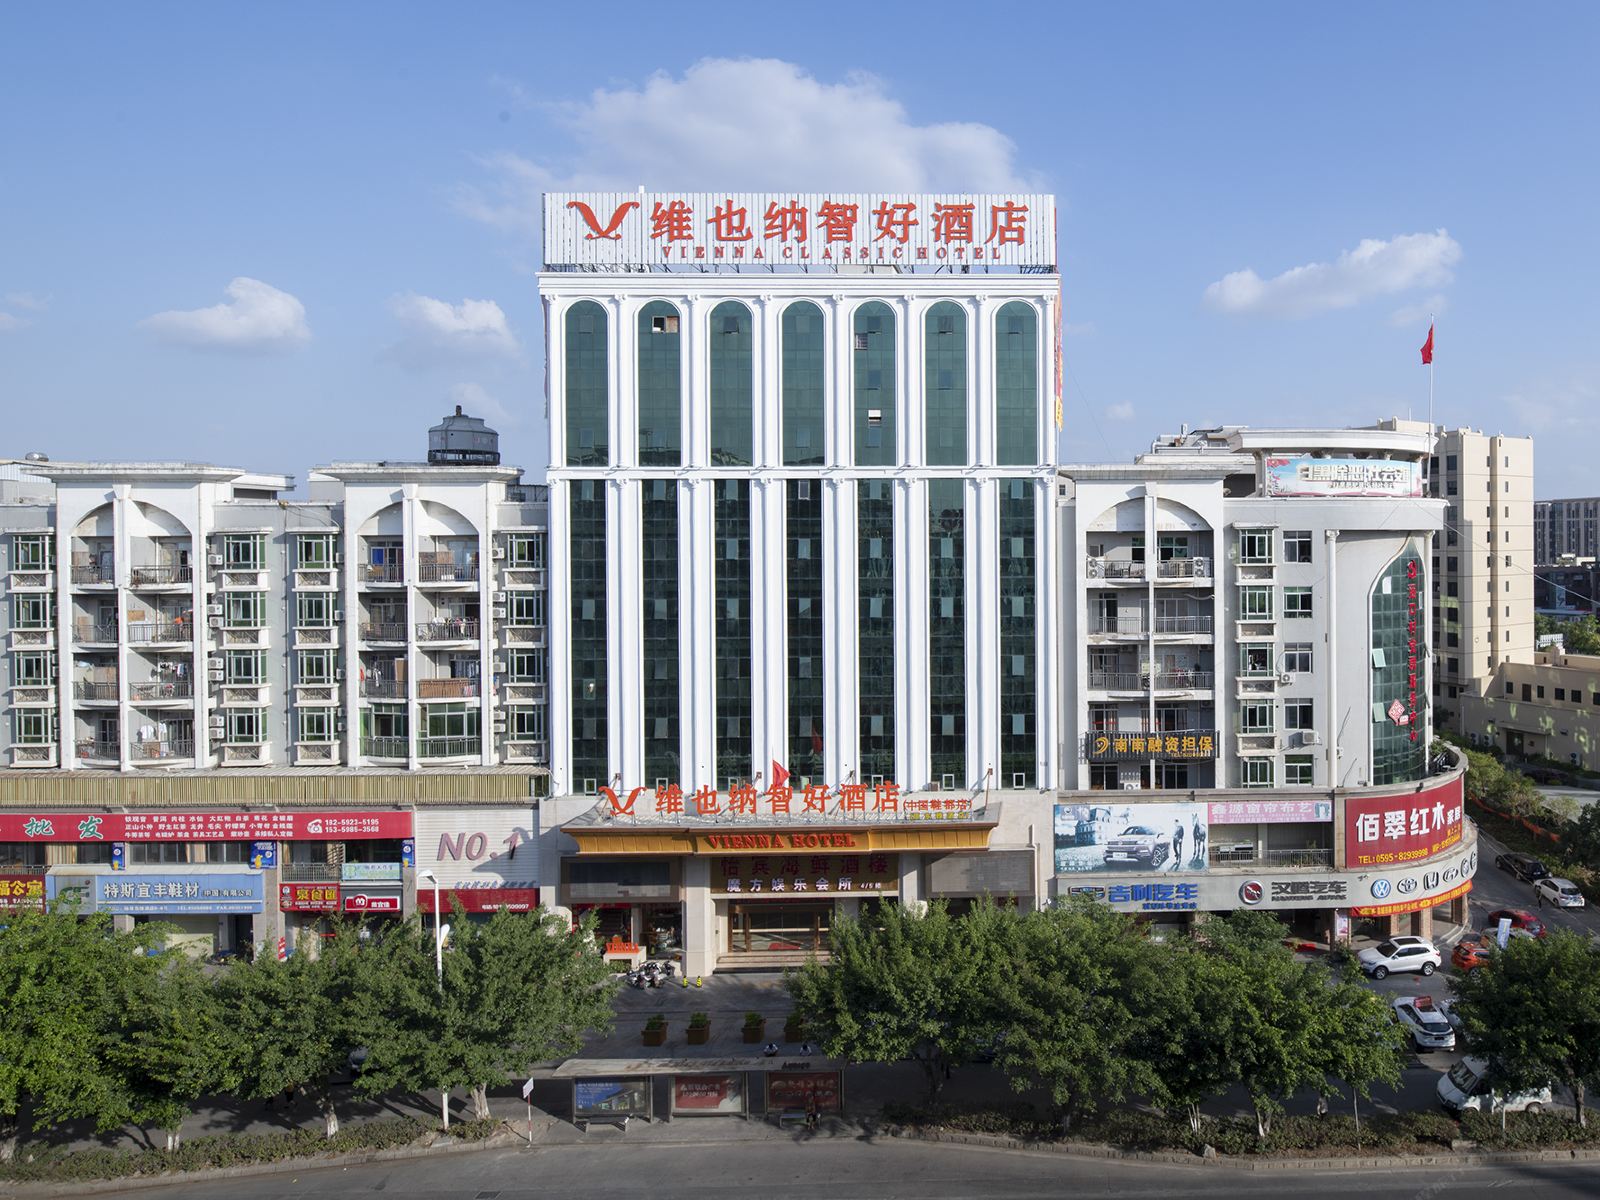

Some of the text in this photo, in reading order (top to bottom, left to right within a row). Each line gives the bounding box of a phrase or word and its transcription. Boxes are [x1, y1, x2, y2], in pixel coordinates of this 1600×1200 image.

[649, 199, 1029, 246] 维也纳智好酒店
[662, 246, 1002, 260] VIENNA CLASSIC HOTEL
[654, 780, 900, 815] 维也纳智好酒店
[23, 816, 104, 840] 批发
[1356, 802, 1445, 842] 佰翠红木
[437, 832, 520, 861] NO.1
[708, 832, 856, 849] VIENNA HOTEL
[104, 882, 200, 898] 特斯宜丰鞋材
[726, 878, 853, 893] 魔方娱乐会所
[1108, 883, 1198, 903] 吉利汽车
